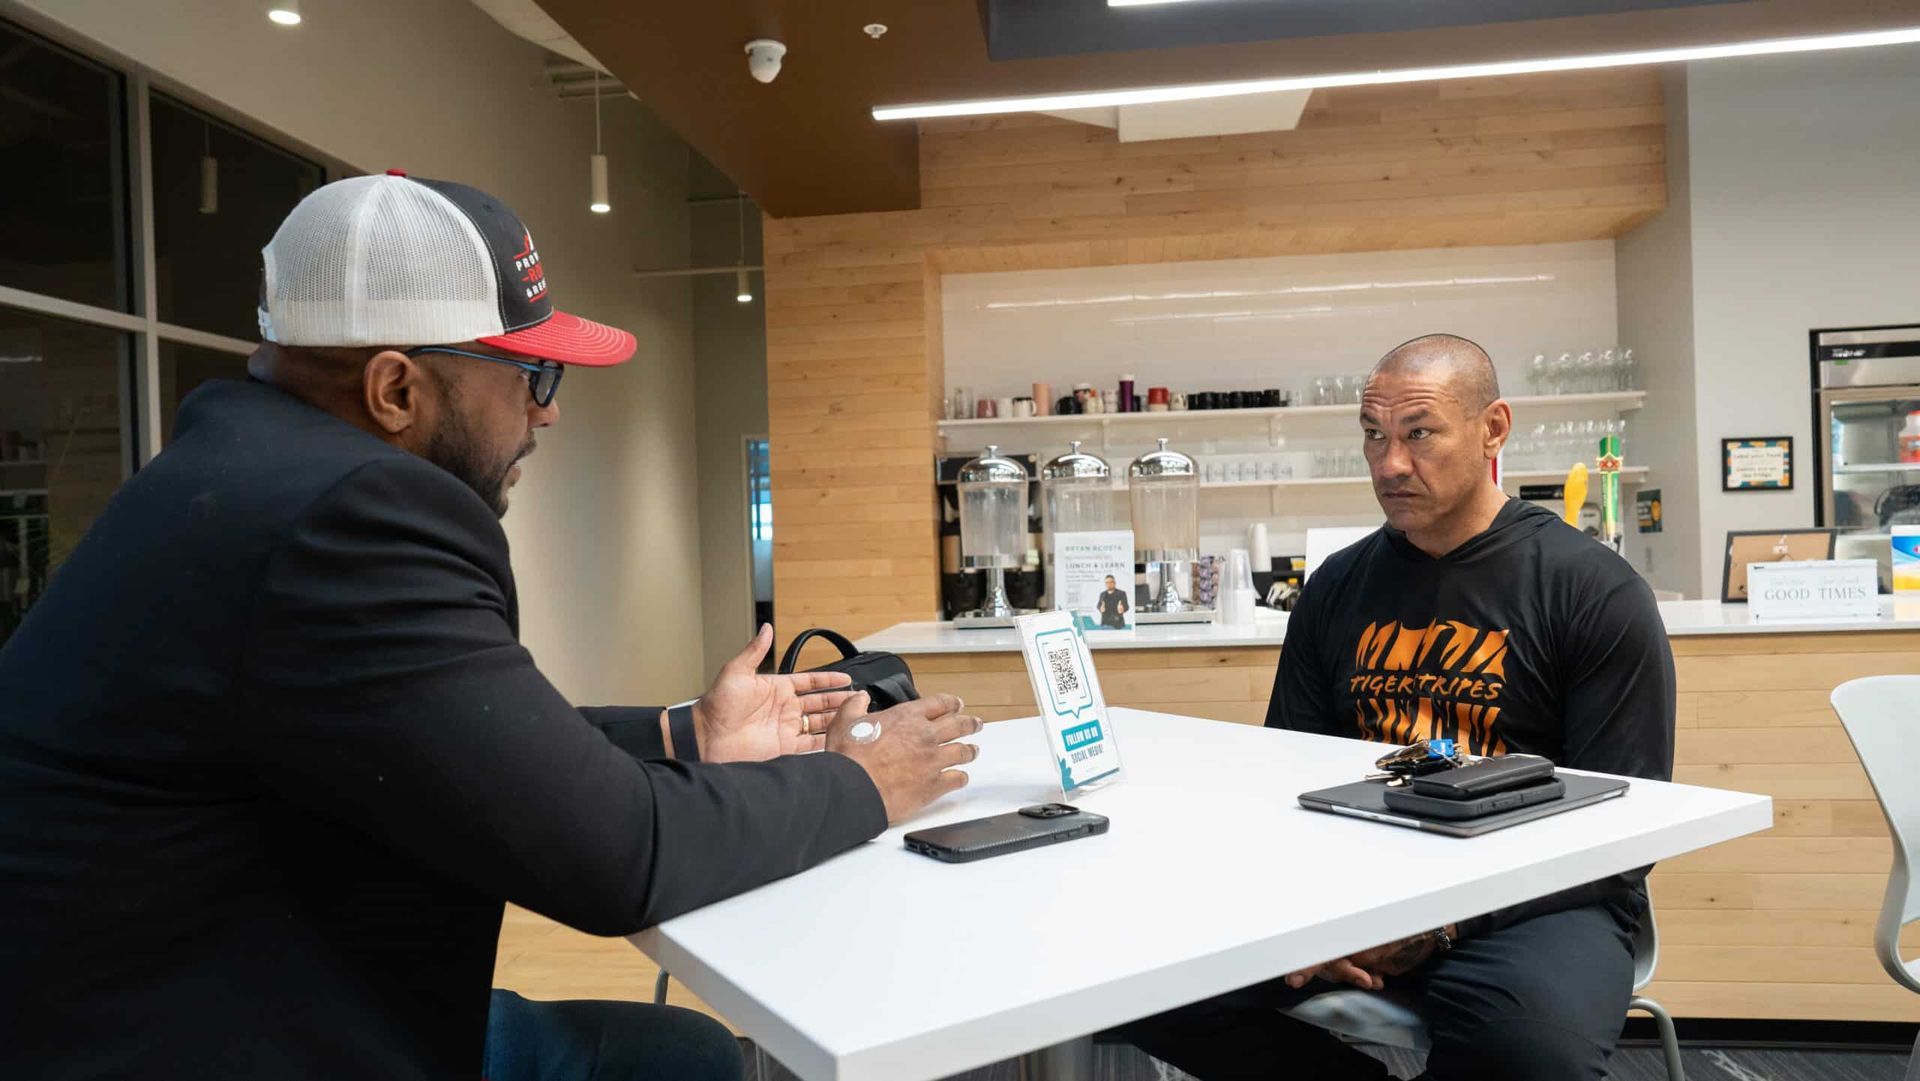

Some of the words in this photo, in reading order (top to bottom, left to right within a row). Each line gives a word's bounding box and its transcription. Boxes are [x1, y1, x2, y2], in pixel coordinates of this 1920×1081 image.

[1764, 588, 1810, 601] GOOD
[1818, 586, 1867, 601] TIMES
[1350, 673, 1503, 700] TIGERTRIPES
[1071, 750, 1088, 764] SOCIAL
